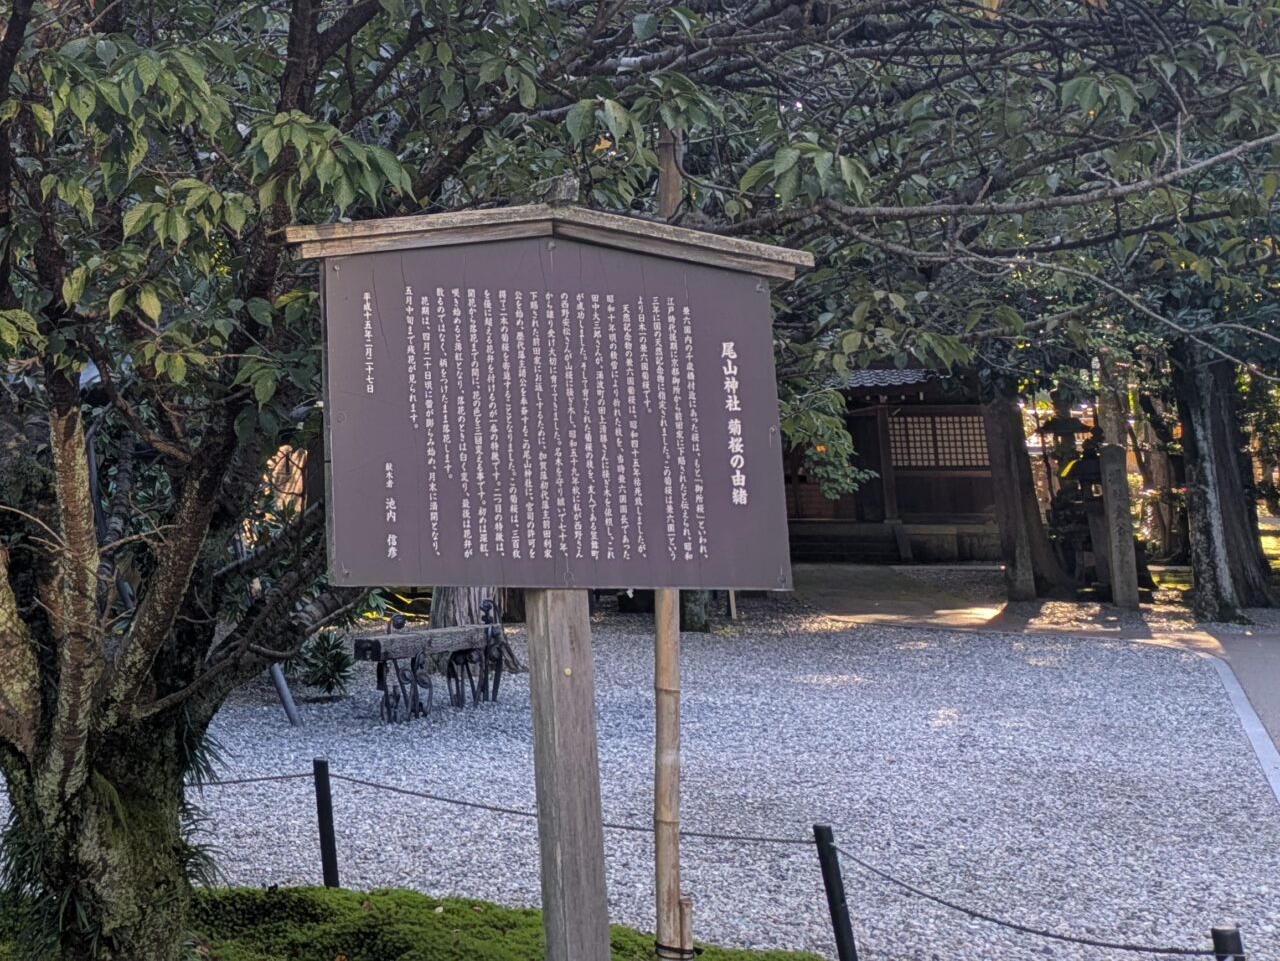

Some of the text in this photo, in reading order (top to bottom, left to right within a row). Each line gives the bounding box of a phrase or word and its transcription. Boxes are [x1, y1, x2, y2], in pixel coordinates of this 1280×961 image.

[364, 292, 374, 393] 平成十五年二月二十七日
[721, 342, 749, 504] 尾山神社 菊桜の由緒
[386, 497, 397, 522] 池内
[387, 533, 398, 559] 信彦
